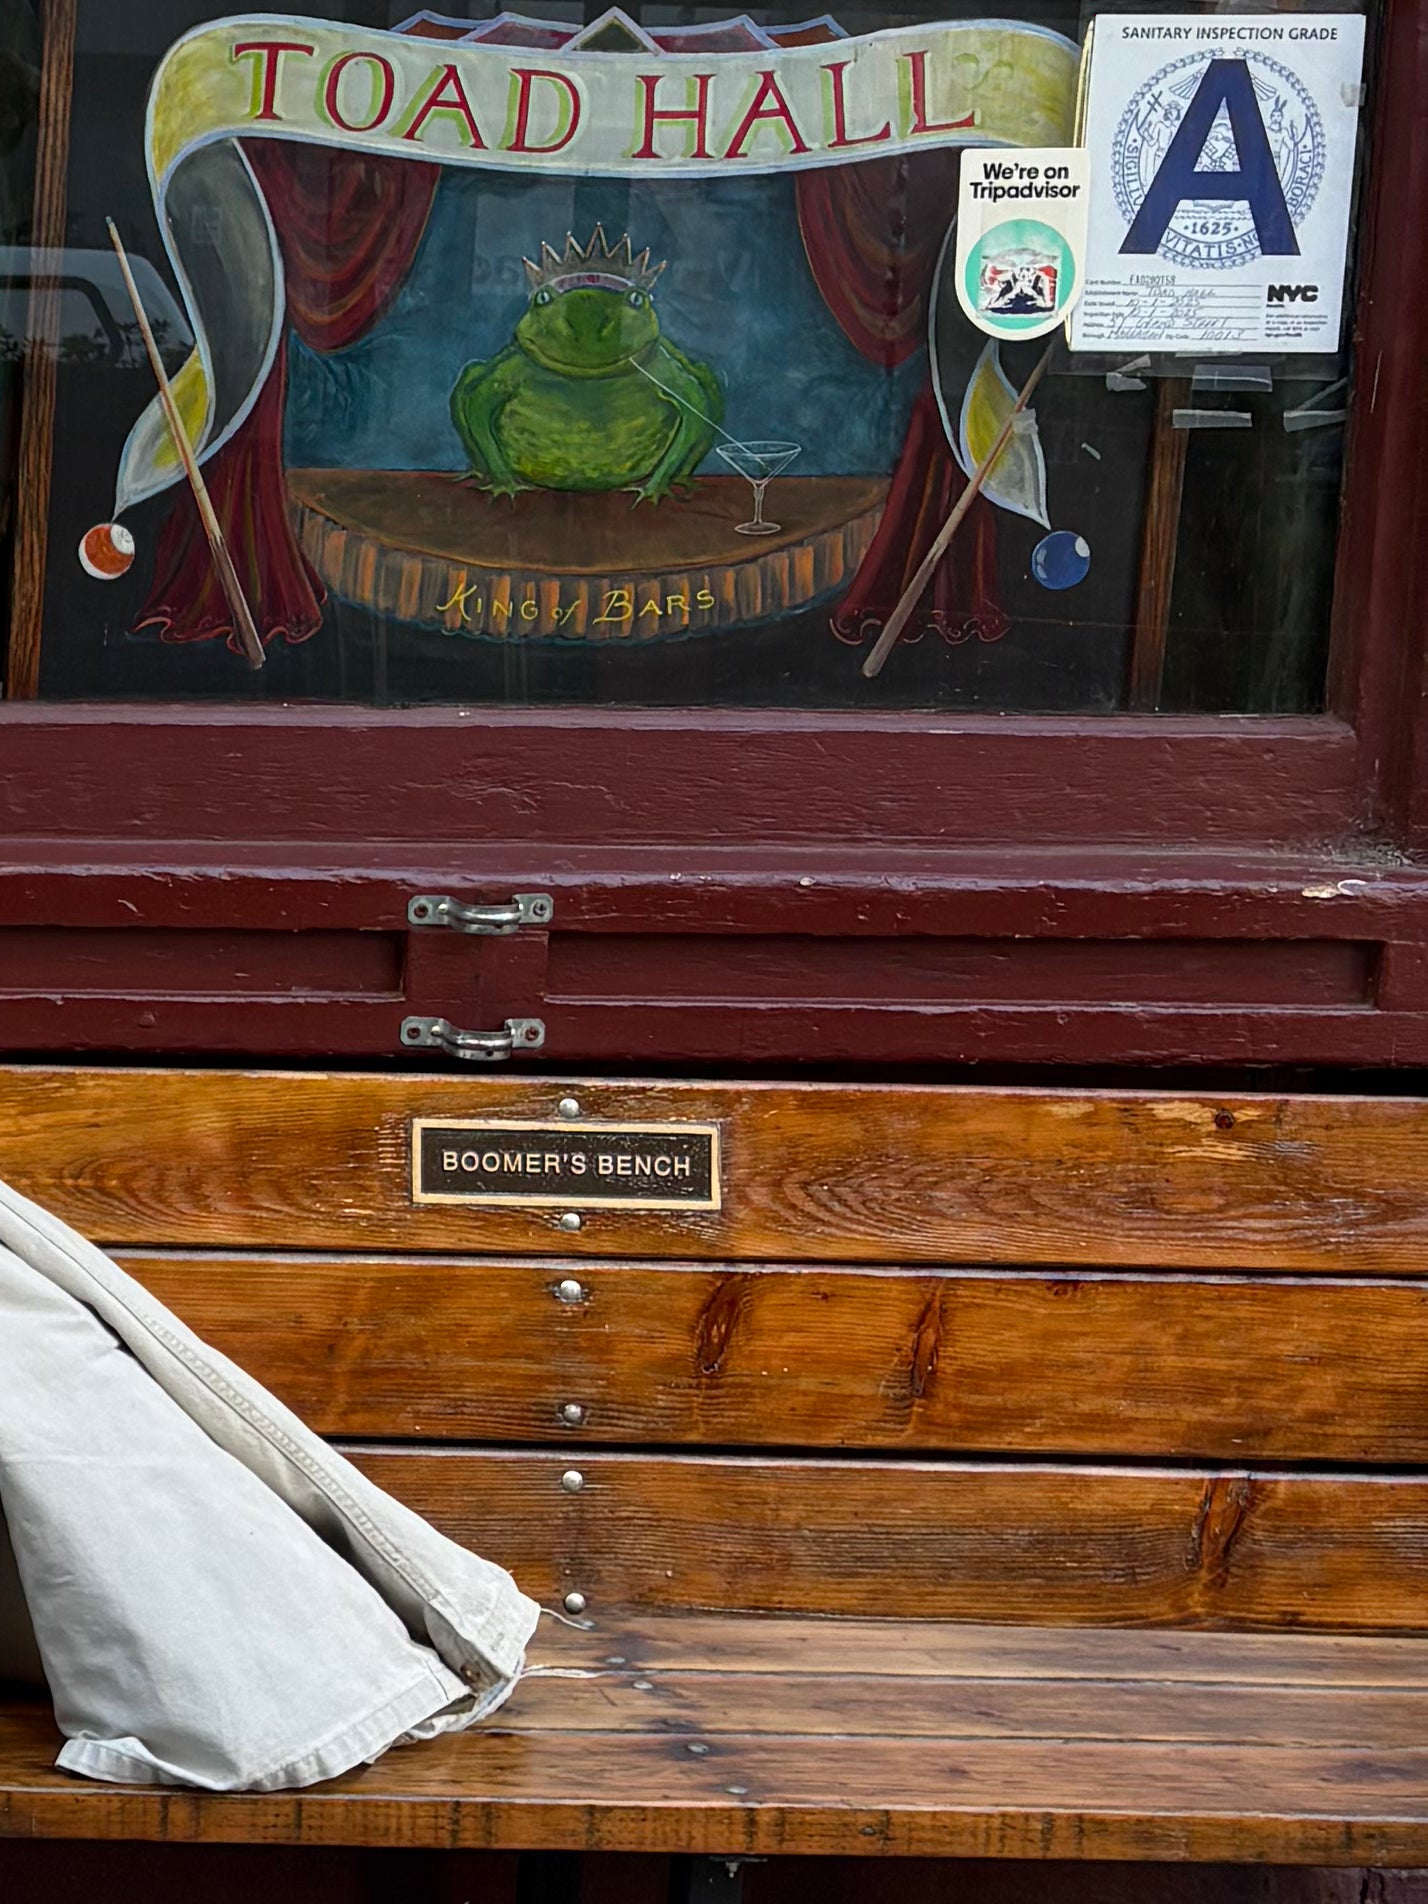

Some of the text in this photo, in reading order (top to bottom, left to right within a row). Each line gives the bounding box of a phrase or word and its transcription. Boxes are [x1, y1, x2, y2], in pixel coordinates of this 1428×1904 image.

[1121, 26, 1339, 41] SANITARY INSPECTION GRADE
[233, 41, 977, 160] TOAD HALL
[1117, 58, 1302, 256] A
[982, 162, 1069, 180] We're on
[1287, 147, 1313, 209] BORACI
[969, 181, 1081, 203] Tripadvisor
[1191, 221, 1233, 237] 1625
[1267, 284, 1319, 302] NYC
[436, 584, 715, 625] KING of BARS
[442, 1150, 691, 1178] BOOMER'S BENCH
